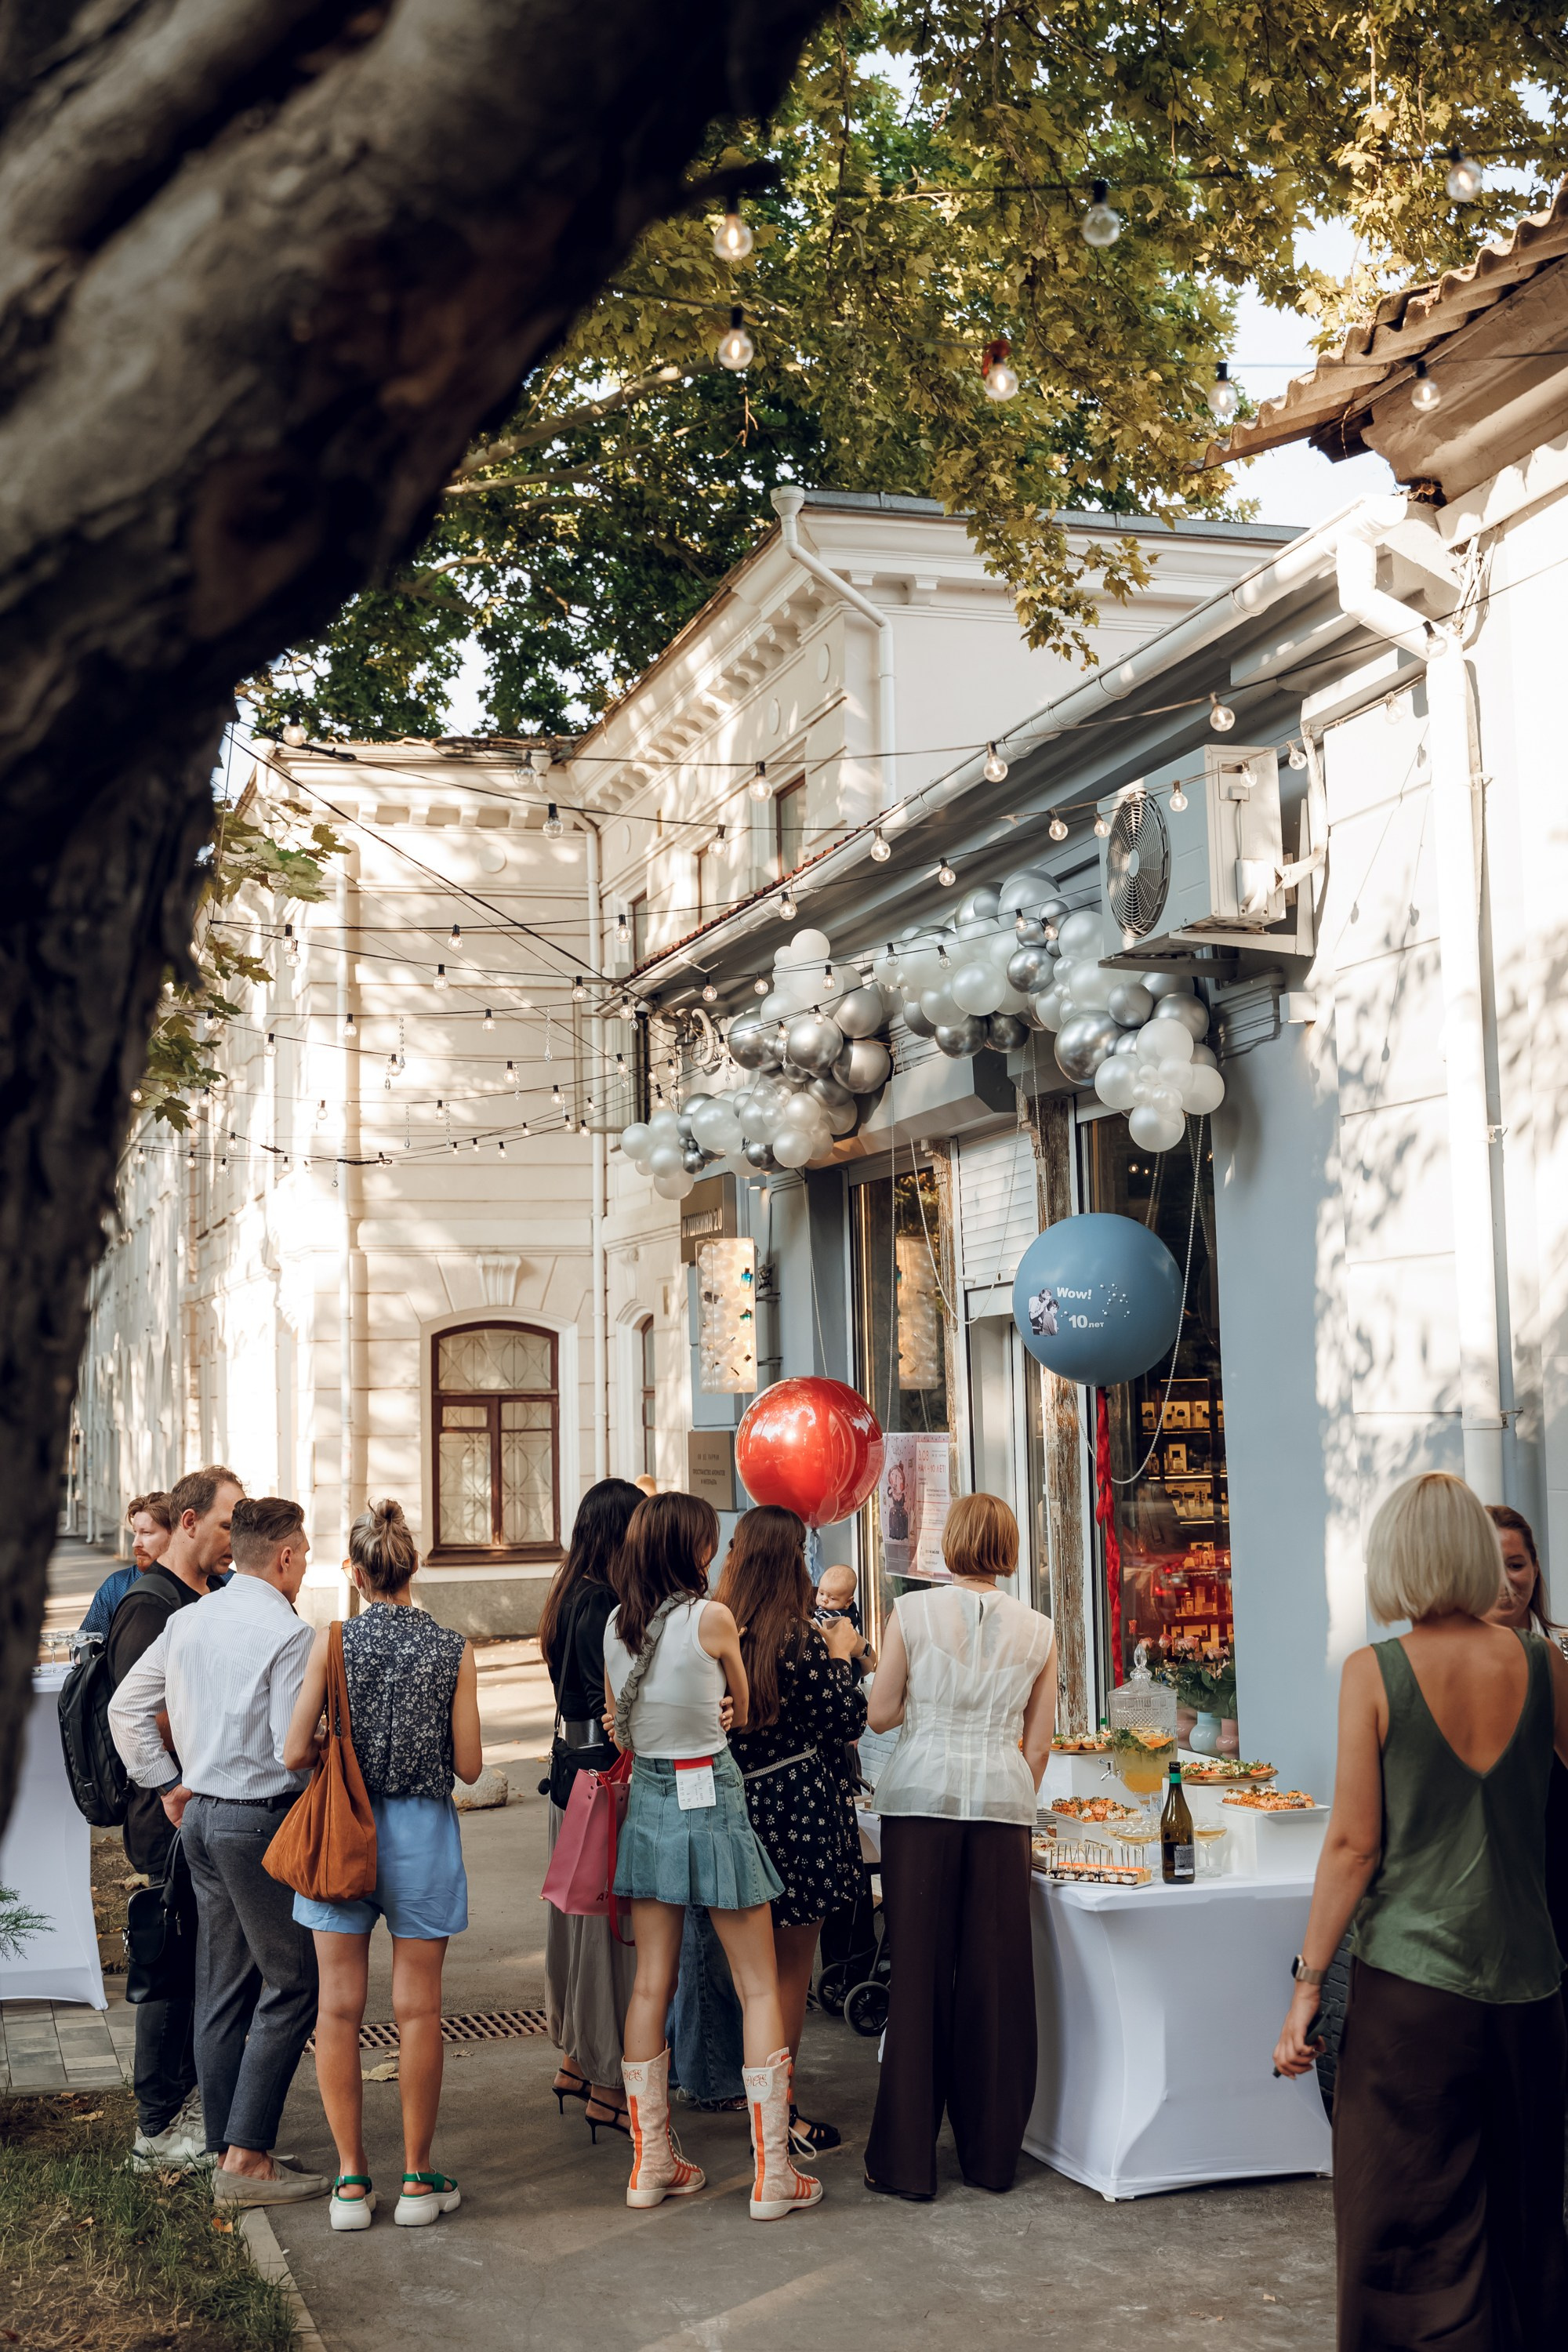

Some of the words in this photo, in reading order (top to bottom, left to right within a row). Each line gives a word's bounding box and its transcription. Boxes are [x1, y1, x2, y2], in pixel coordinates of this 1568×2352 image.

[681, 1210, 713, 1239] ПУШКИНА
[713, 1207, 723, 1231] 20
[1057, 1287, 1092, 1299] Wow!
